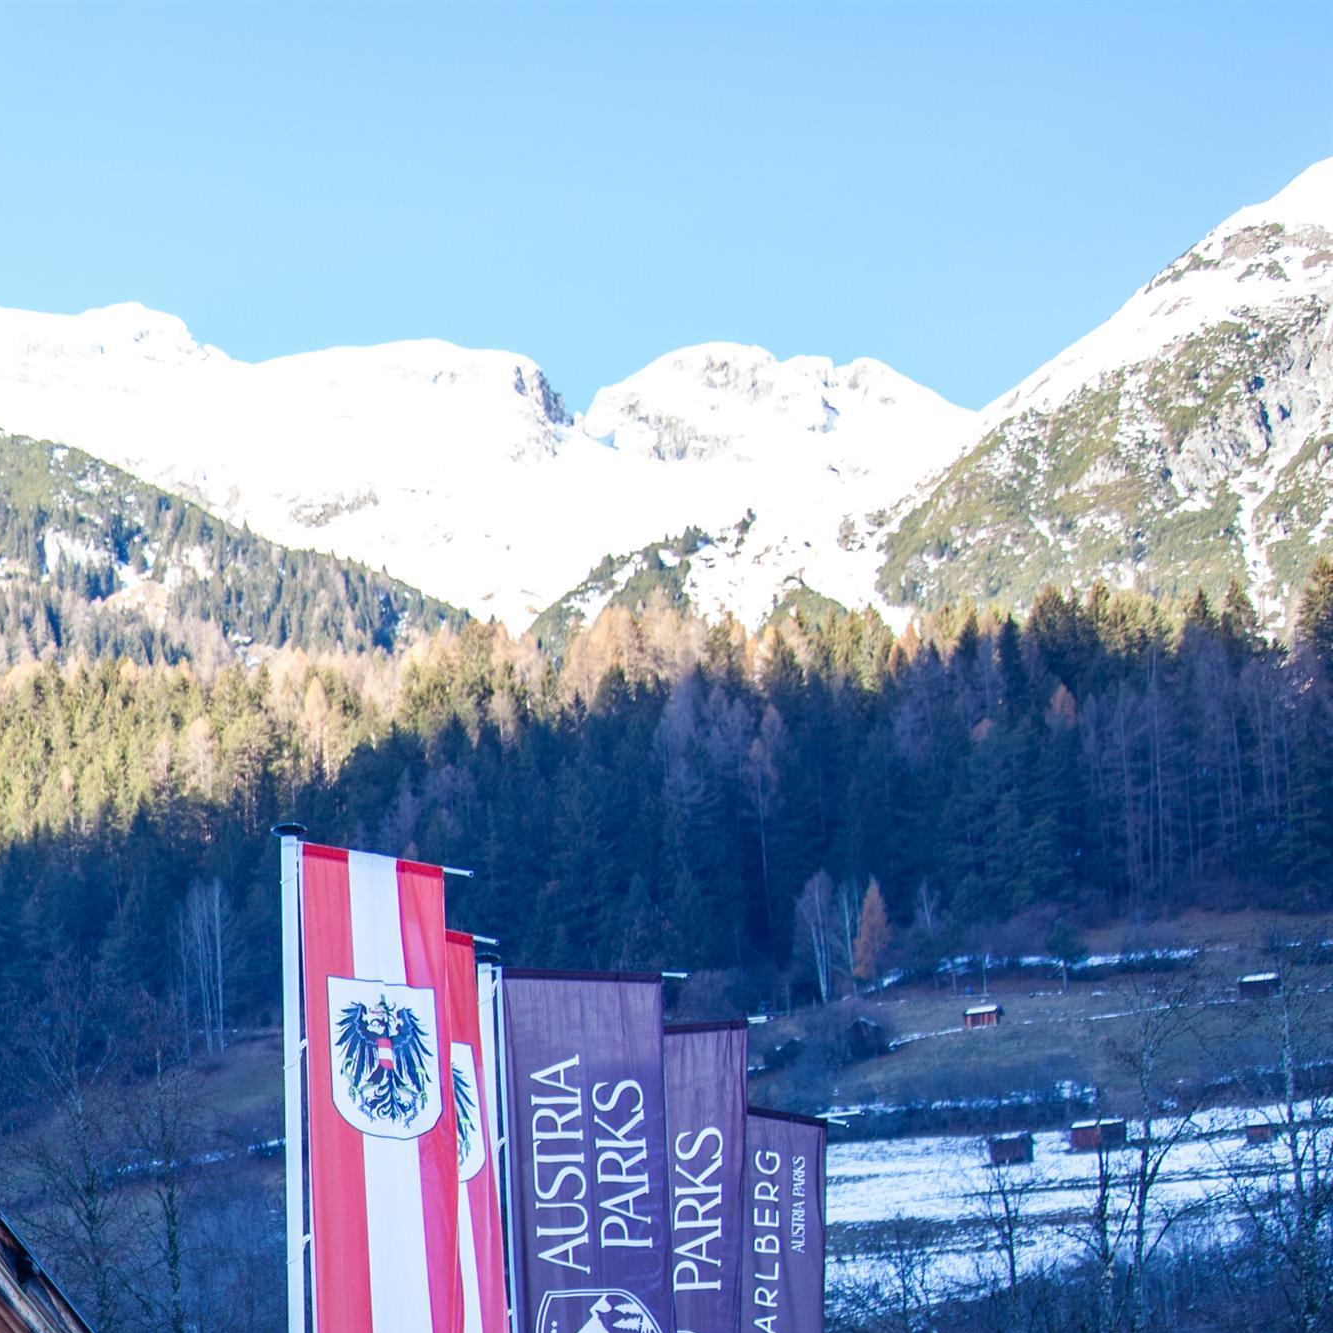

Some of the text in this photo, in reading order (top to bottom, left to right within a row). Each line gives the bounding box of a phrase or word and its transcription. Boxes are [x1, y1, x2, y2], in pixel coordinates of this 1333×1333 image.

[530, 1054, 590, 1275] AUSTRIA
[592, 1079, 653, 1249] PARKS
[673, 1126, 723, 1293] PARKS
[790, 1155, 806, 1254] AUSTRIA PARKS
